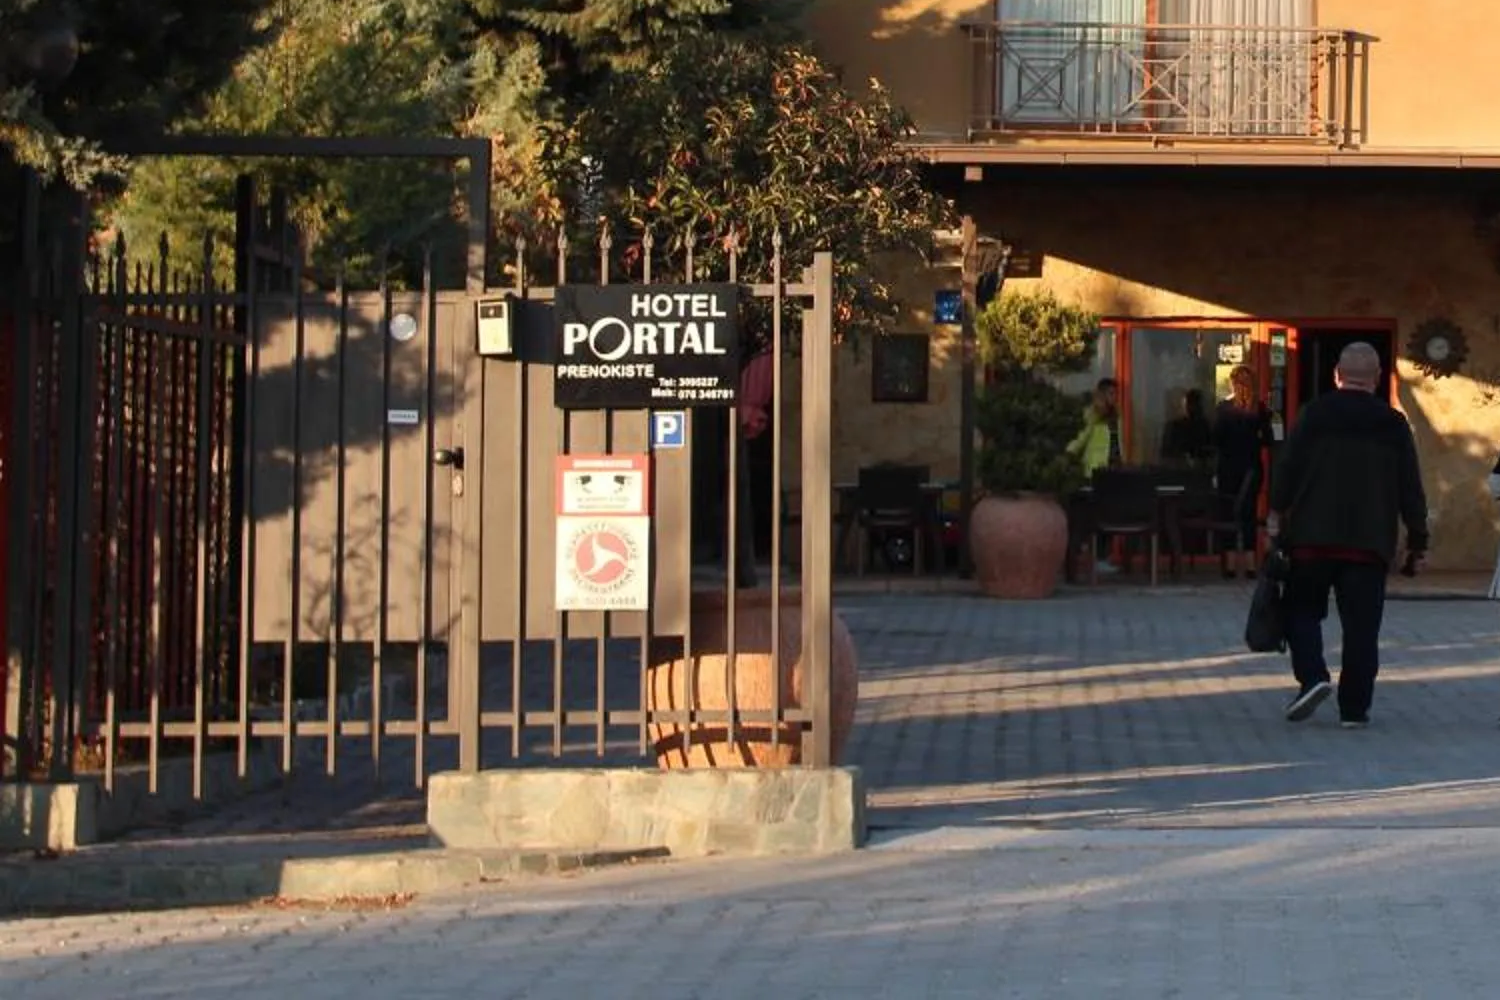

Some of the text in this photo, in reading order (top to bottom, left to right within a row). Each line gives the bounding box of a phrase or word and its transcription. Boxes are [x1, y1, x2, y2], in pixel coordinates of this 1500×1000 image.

[631, 293, 727, 318] HOTEL
[562, 316, 727, 361] PORTAL
[557, 363, 655, 379] PRENOKISTE
[657, 416, 678, 443] P
